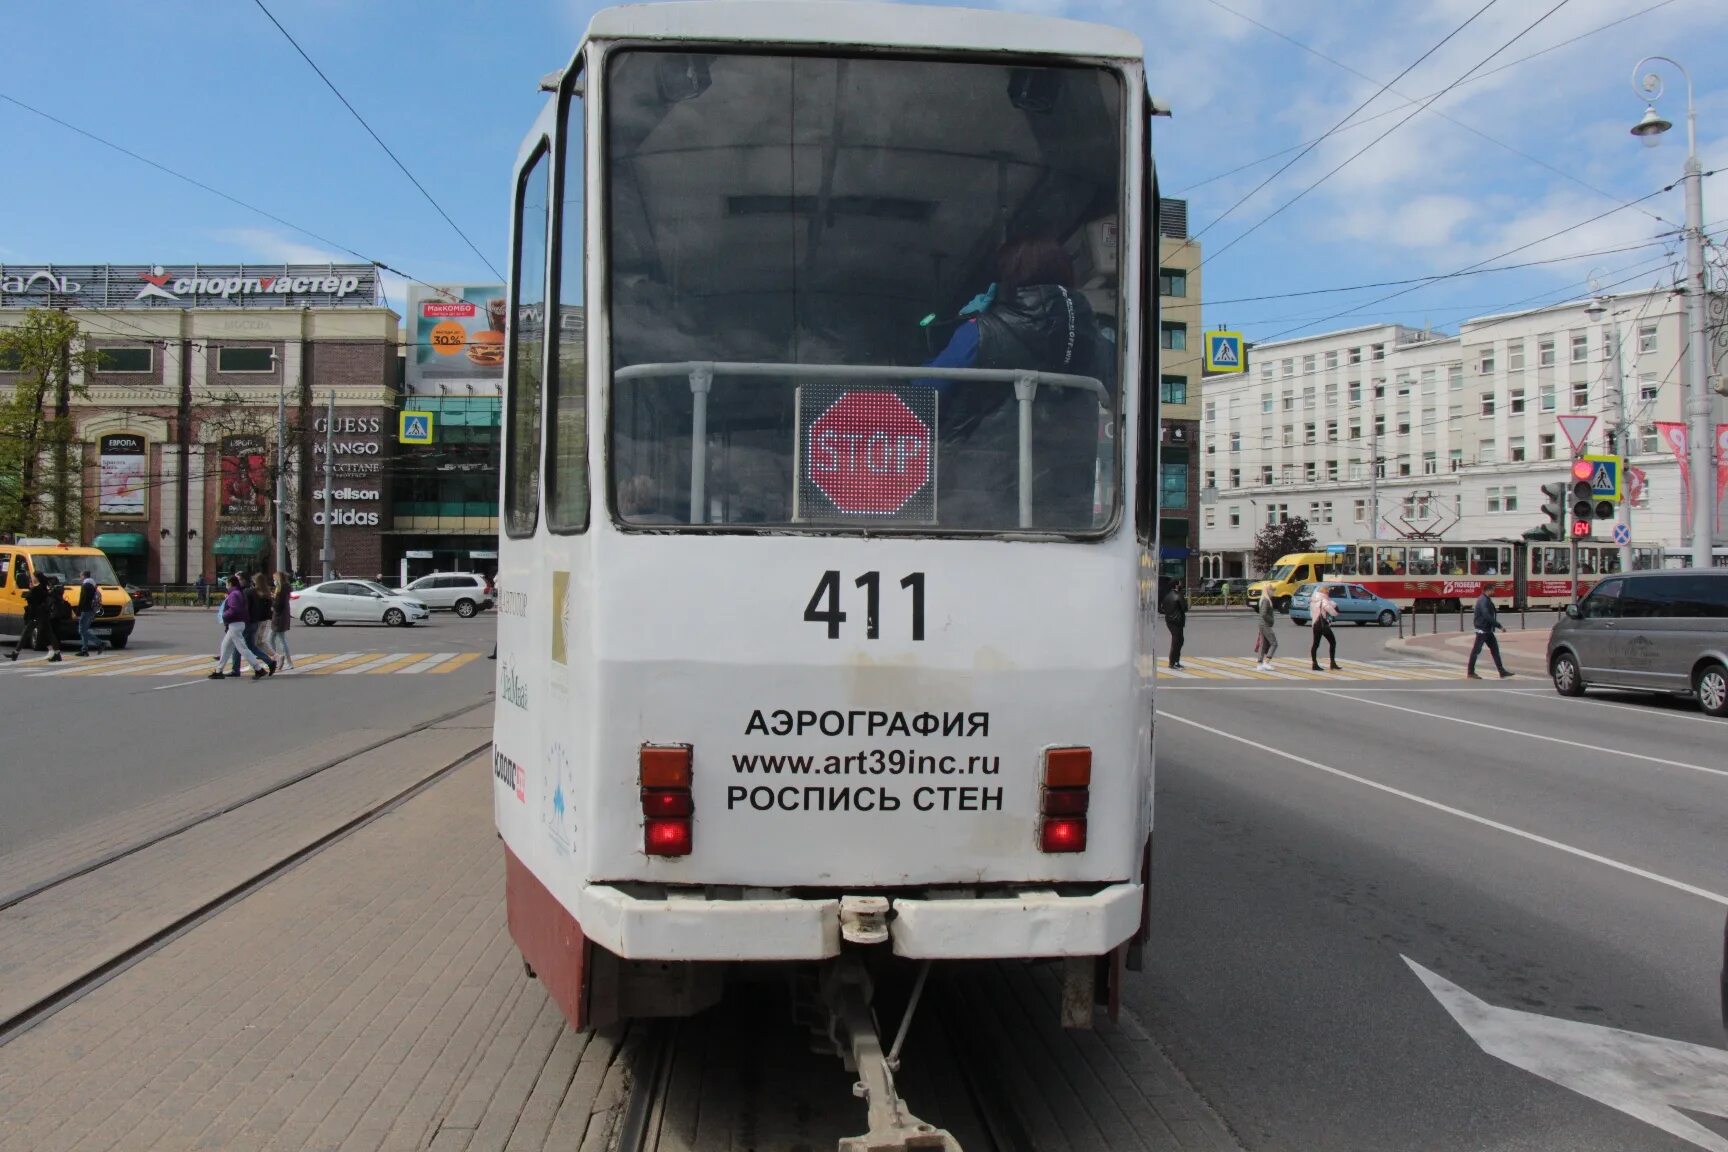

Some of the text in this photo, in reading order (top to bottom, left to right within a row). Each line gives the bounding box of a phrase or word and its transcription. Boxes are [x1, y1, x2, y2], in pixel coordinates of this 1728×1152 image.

[109, 439, 137, 447] ЕВРОПА
[817, 429, 922, 473] STOP
[1574, 522, 1589, 535] 64
[803, 570, 925, 641] 411
[744, 709, 989, 737] АЭРОГРАФИЯ
[731, 749, 1000, 775] www.art39inc.ru
[727, 785, 1003, 811] РОСПИСЬ СТЕН
